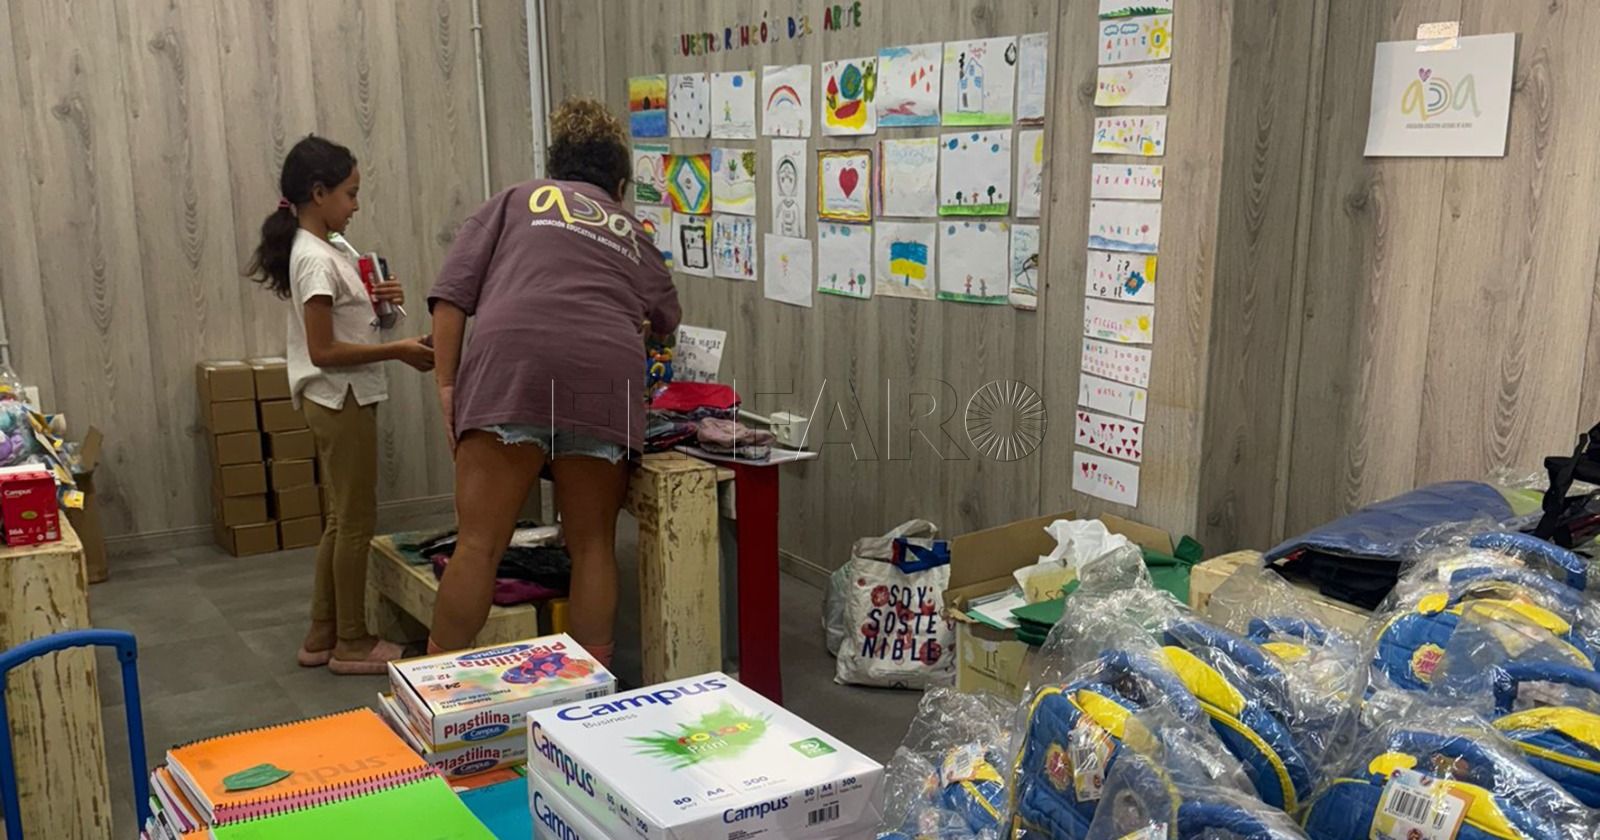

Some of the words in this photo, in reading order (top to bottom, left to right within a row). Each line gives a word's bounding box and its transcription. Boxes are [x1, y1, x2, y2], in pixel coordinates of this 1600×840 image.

[788, 15, 812, 38] DEL
[824, 1, 862, 31] ARTE
[888, 584, 927, 609] SOY
[867, 608, 938, 636] SOSTE
[457, 641, 567, 670] Plastilina
[861, 636, 938, 662] NIBLE
[557, 678, 728, 721] Campus
[444, 710, 511, 739] Plastilina
[470, 725, 500, 737] Campus
[582, 712, 638, 729] Business
[435, 746, 501, 771] Plastilina
[531, 720, 596, 798] Campus
[687, 739, 729, 754] Print
[673, 796, 692, 806] 80
[743, 775, 769, 787] 500
[723, 796, 789, 824] Campus
[842, 776, 857, 788] 500
